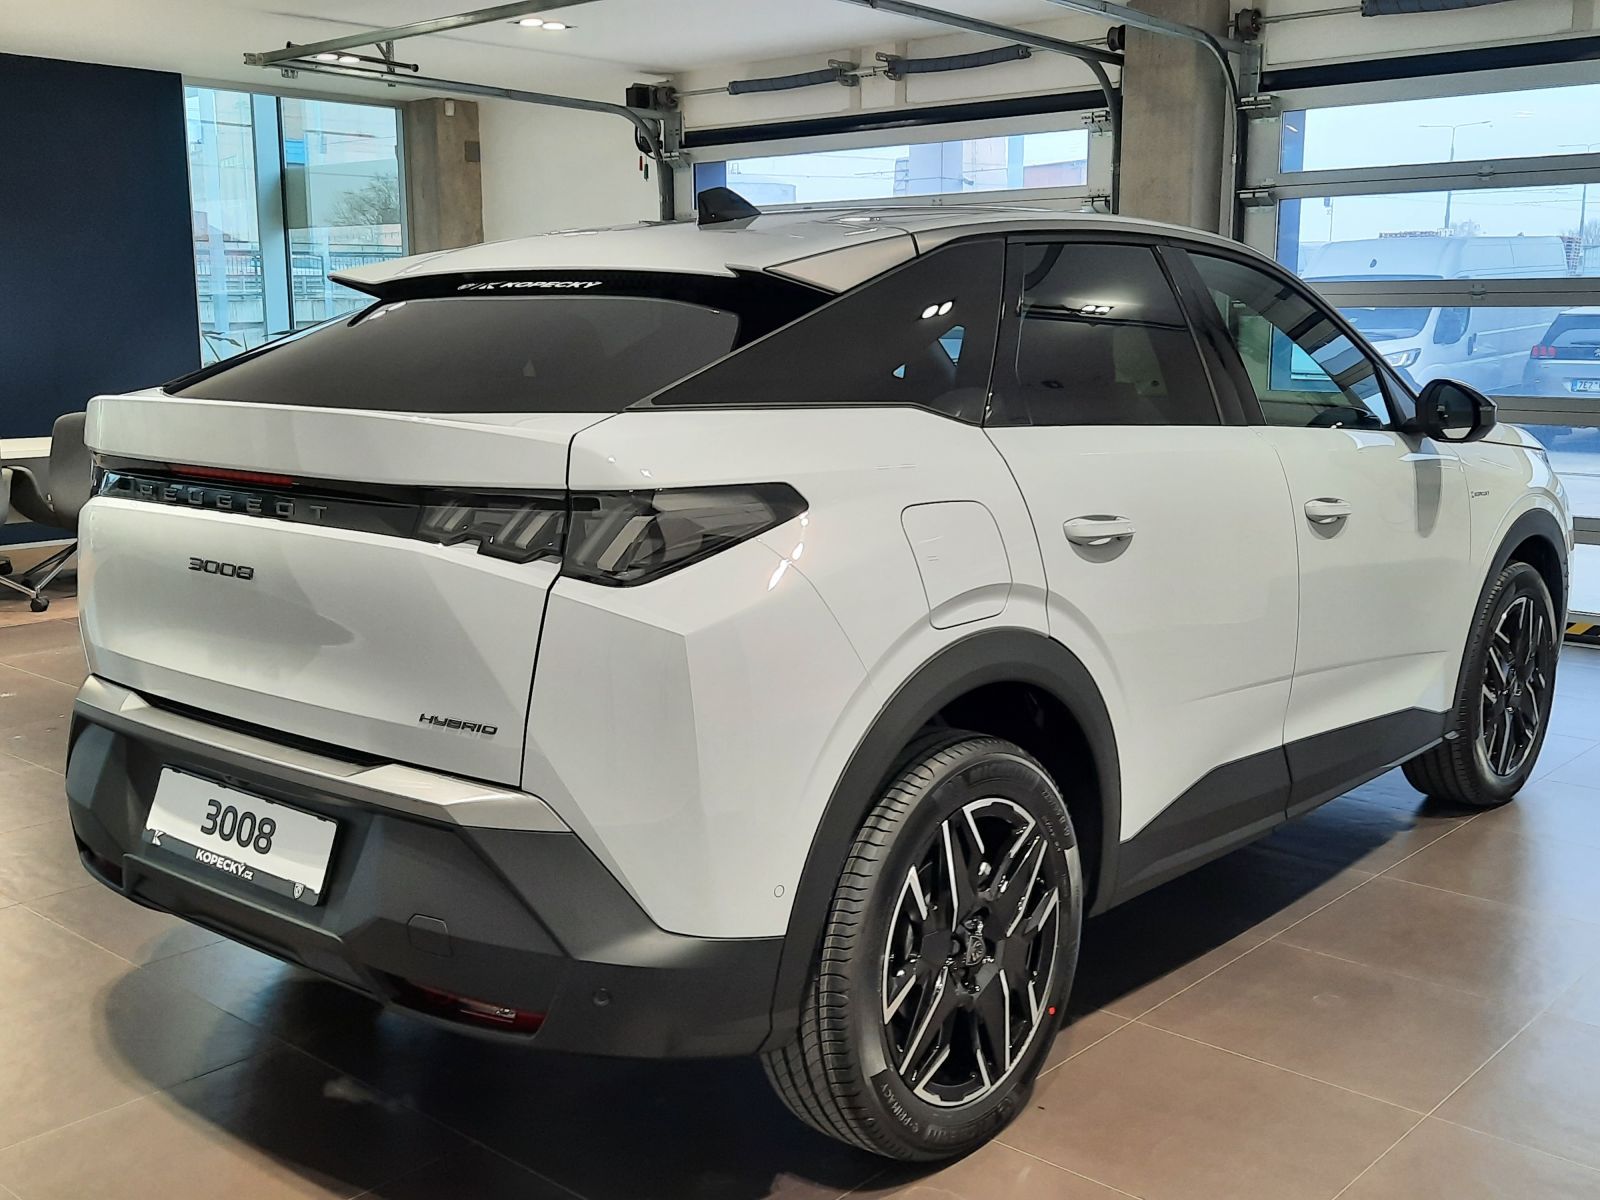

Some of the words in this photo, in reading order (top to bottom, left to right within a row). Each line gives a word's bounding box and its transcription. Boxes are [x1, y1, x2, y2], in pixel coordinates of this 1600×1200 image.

[138, 484, 328, 520] PEUGEOT
[188, 556, 255, 581] 3008
[418, 713, 499, 735] HYBRID
[200, 798, 277, 855] 3008
